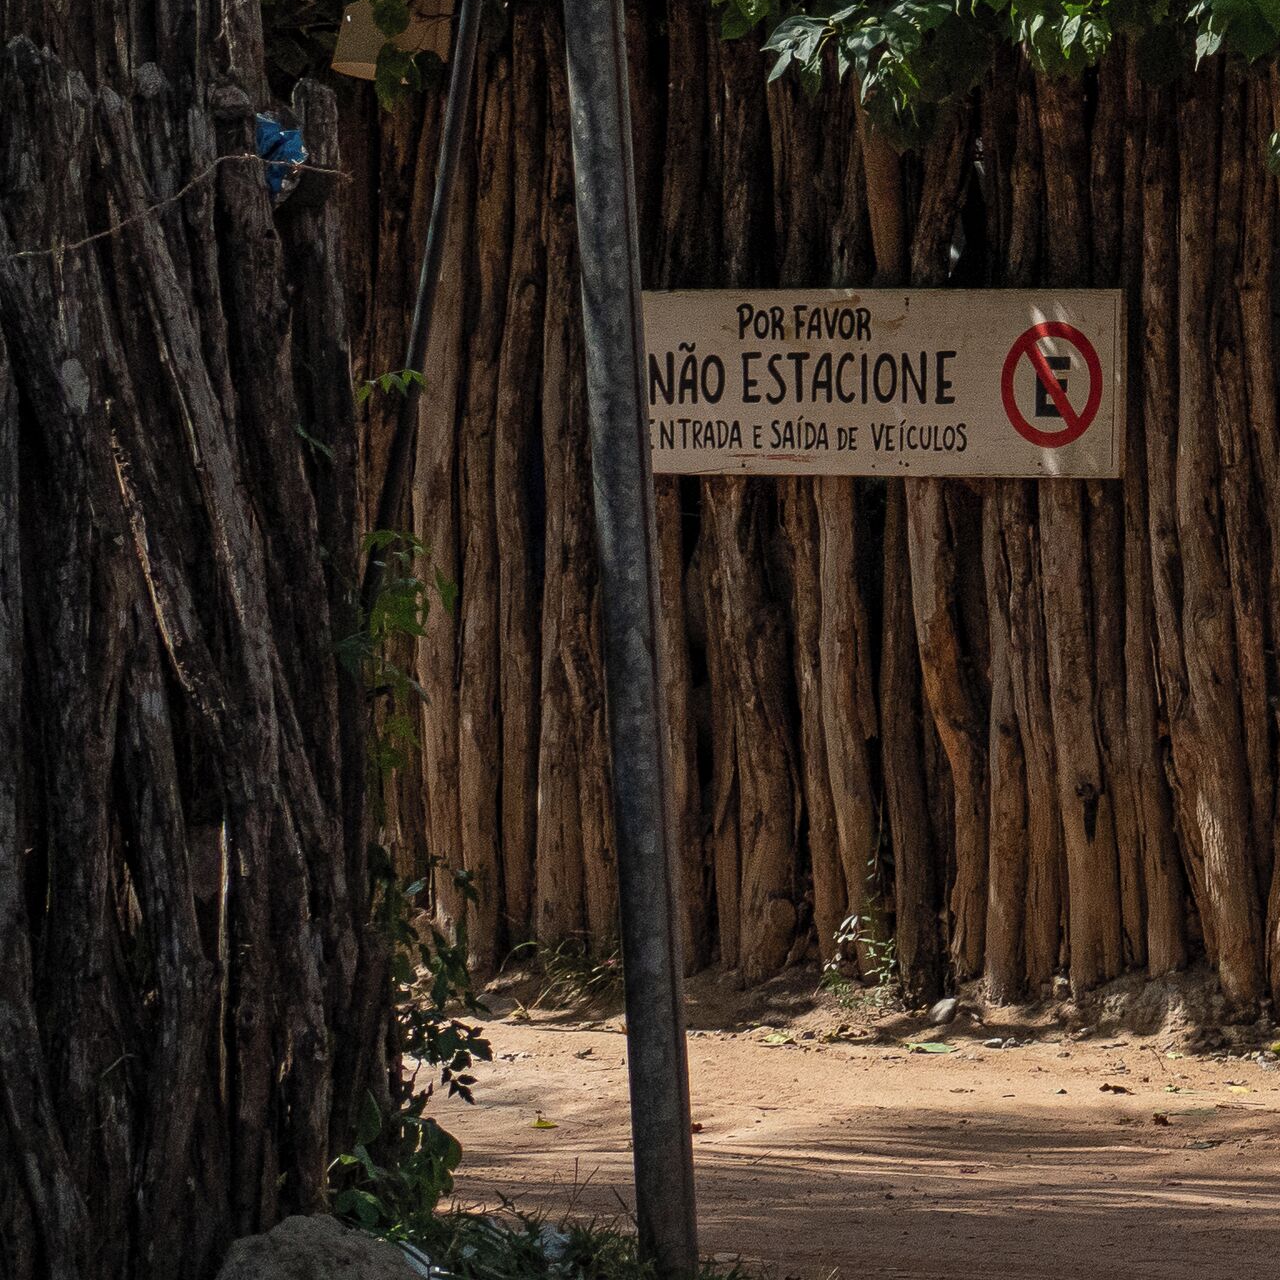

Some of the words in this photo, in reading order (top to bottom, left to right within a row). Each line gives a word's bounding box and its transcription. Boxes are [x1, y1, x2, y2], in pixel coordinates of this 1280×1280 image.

[736, 302, 787, 341] POR
[793, 304, 873, 341] FAVOR
[649, 341, 726, 405] NÃO
[741, 349, 957, 405] ESTACIONE
[752, 423, 763, 450] E
[769, 414, 829, 450] SAÍDA
[837, 425, 858, 451] DE
[870, 418, 968, 452] VEÍCULOS
